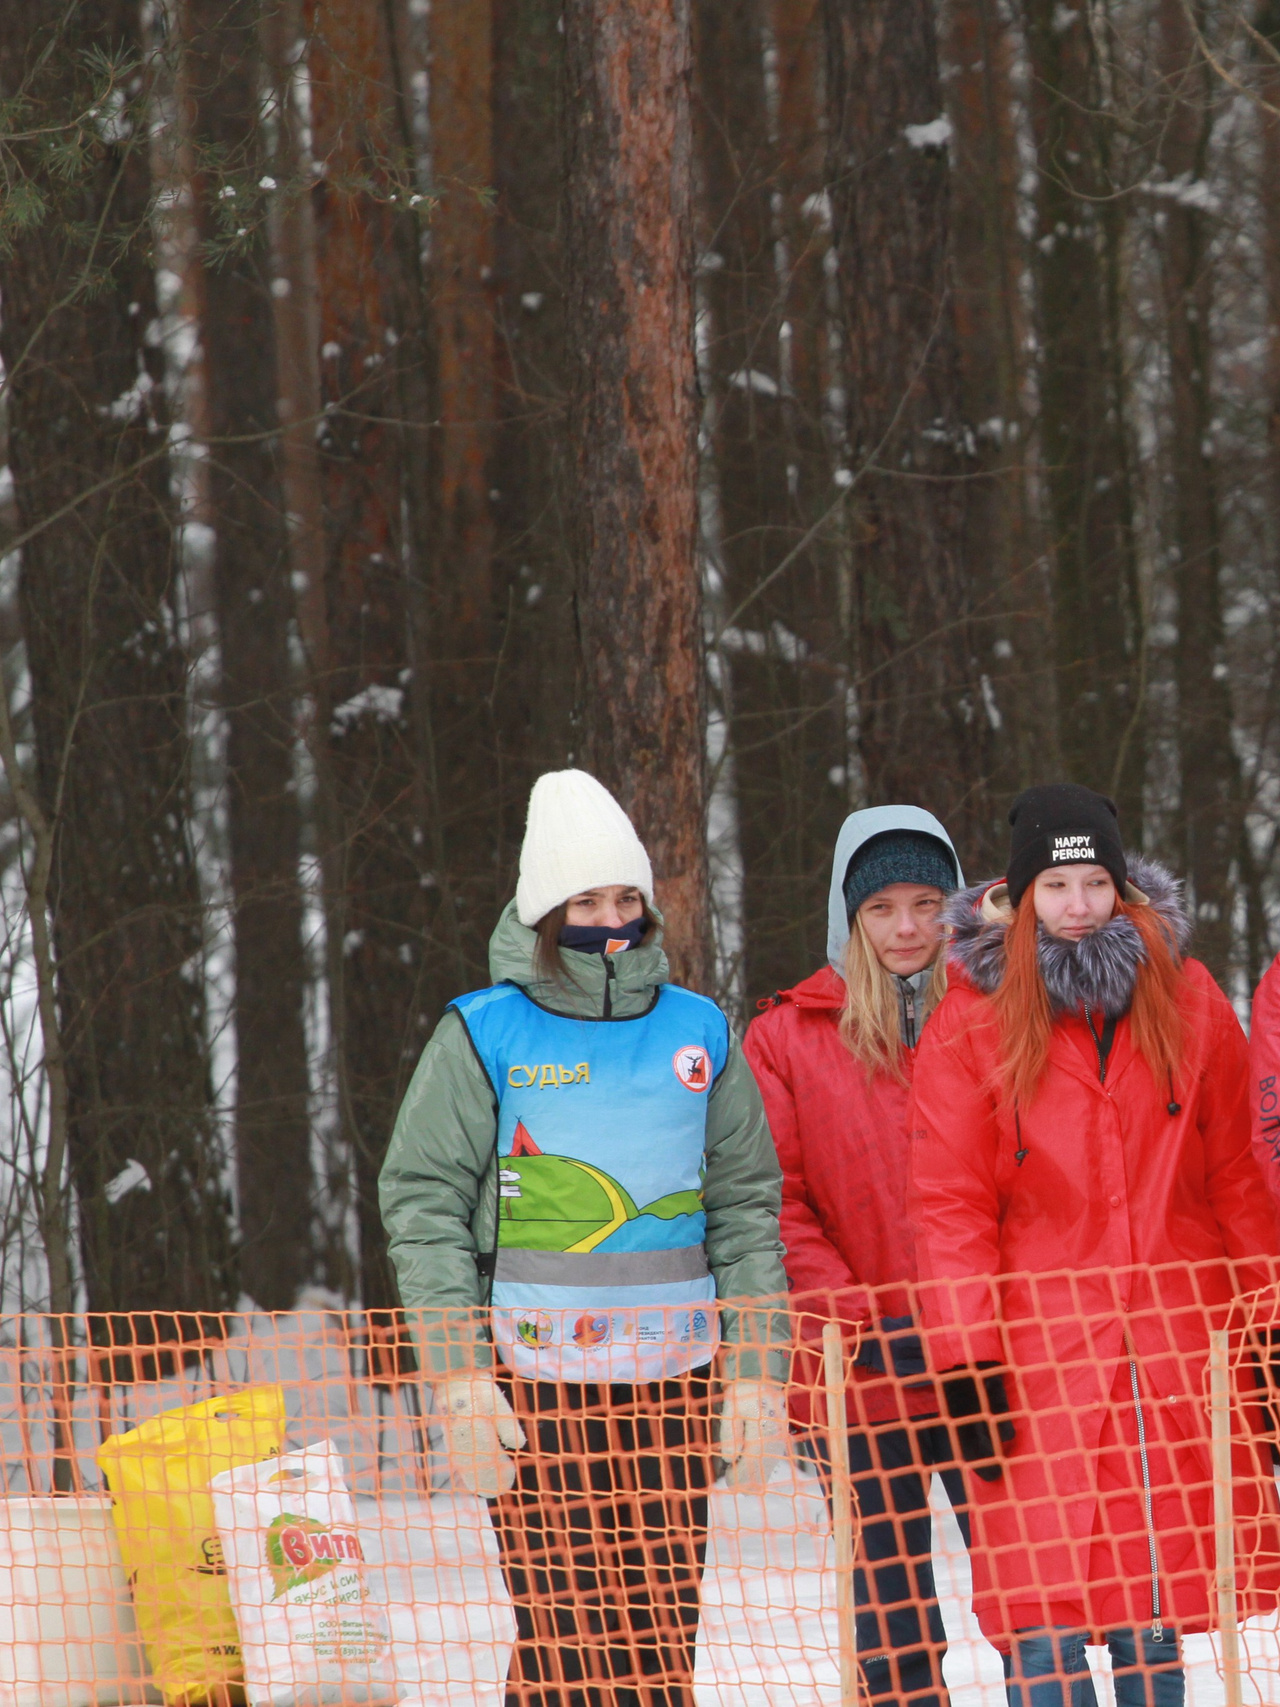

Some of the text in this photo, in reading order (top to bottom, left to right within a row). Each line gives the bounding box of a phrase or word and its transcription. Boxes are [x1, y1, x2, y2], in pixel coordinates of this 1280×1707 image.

[1054, 836, 1090, 848] HAPPY
[1052, 848, 1095, 861] PERSON
[508, 1062, 590, 1090] СУДЬЯ
